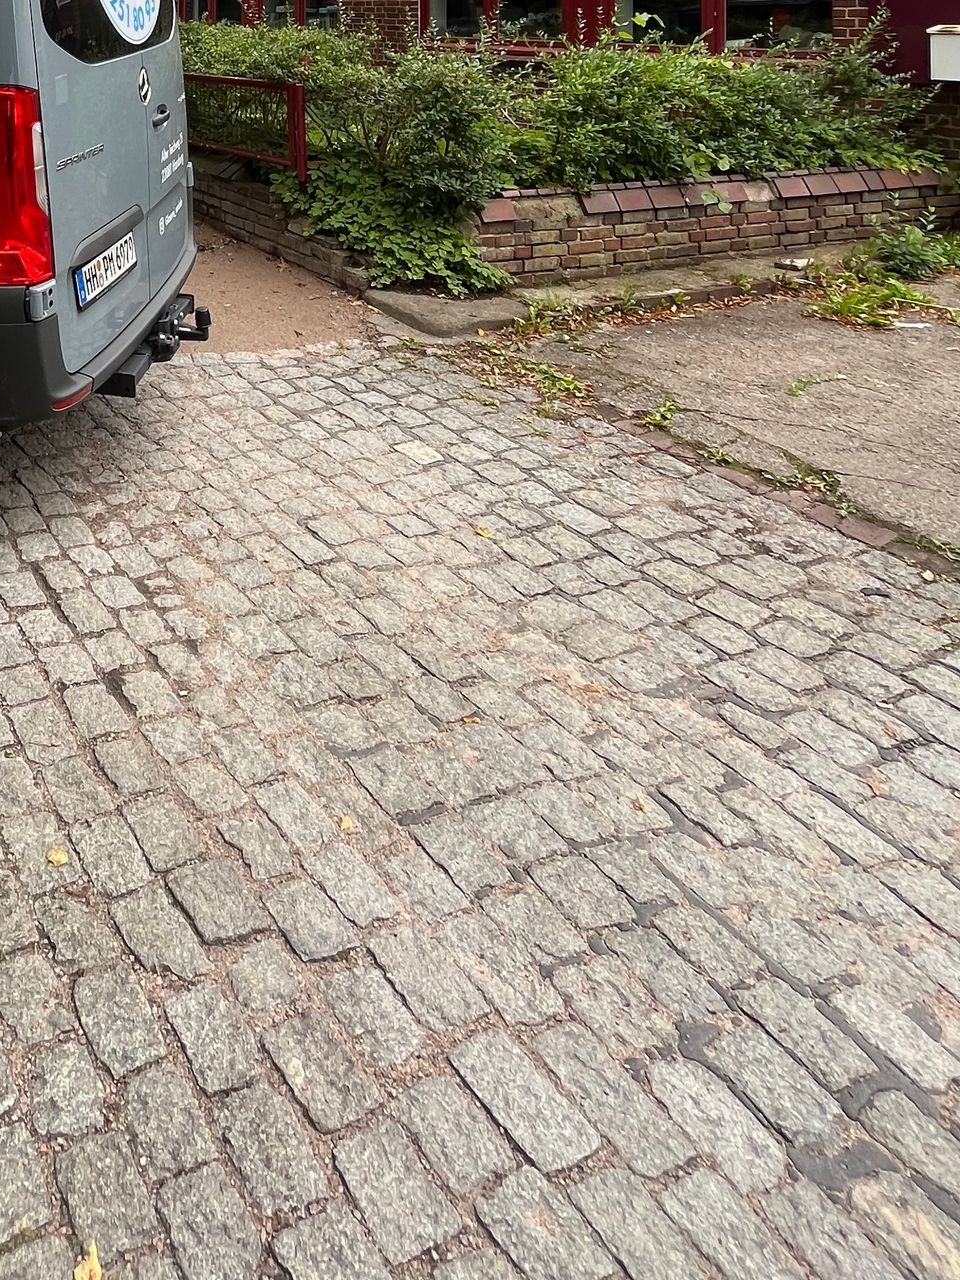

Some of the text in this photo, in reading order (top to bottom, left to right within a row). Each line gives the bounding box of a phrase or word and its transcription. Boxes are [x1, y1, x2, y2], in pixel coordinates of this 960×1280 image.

[133, 6, 145, 32] 80
[56, 143, 105, 171] SPRINTER
[84, 263, 100, 296] HH
